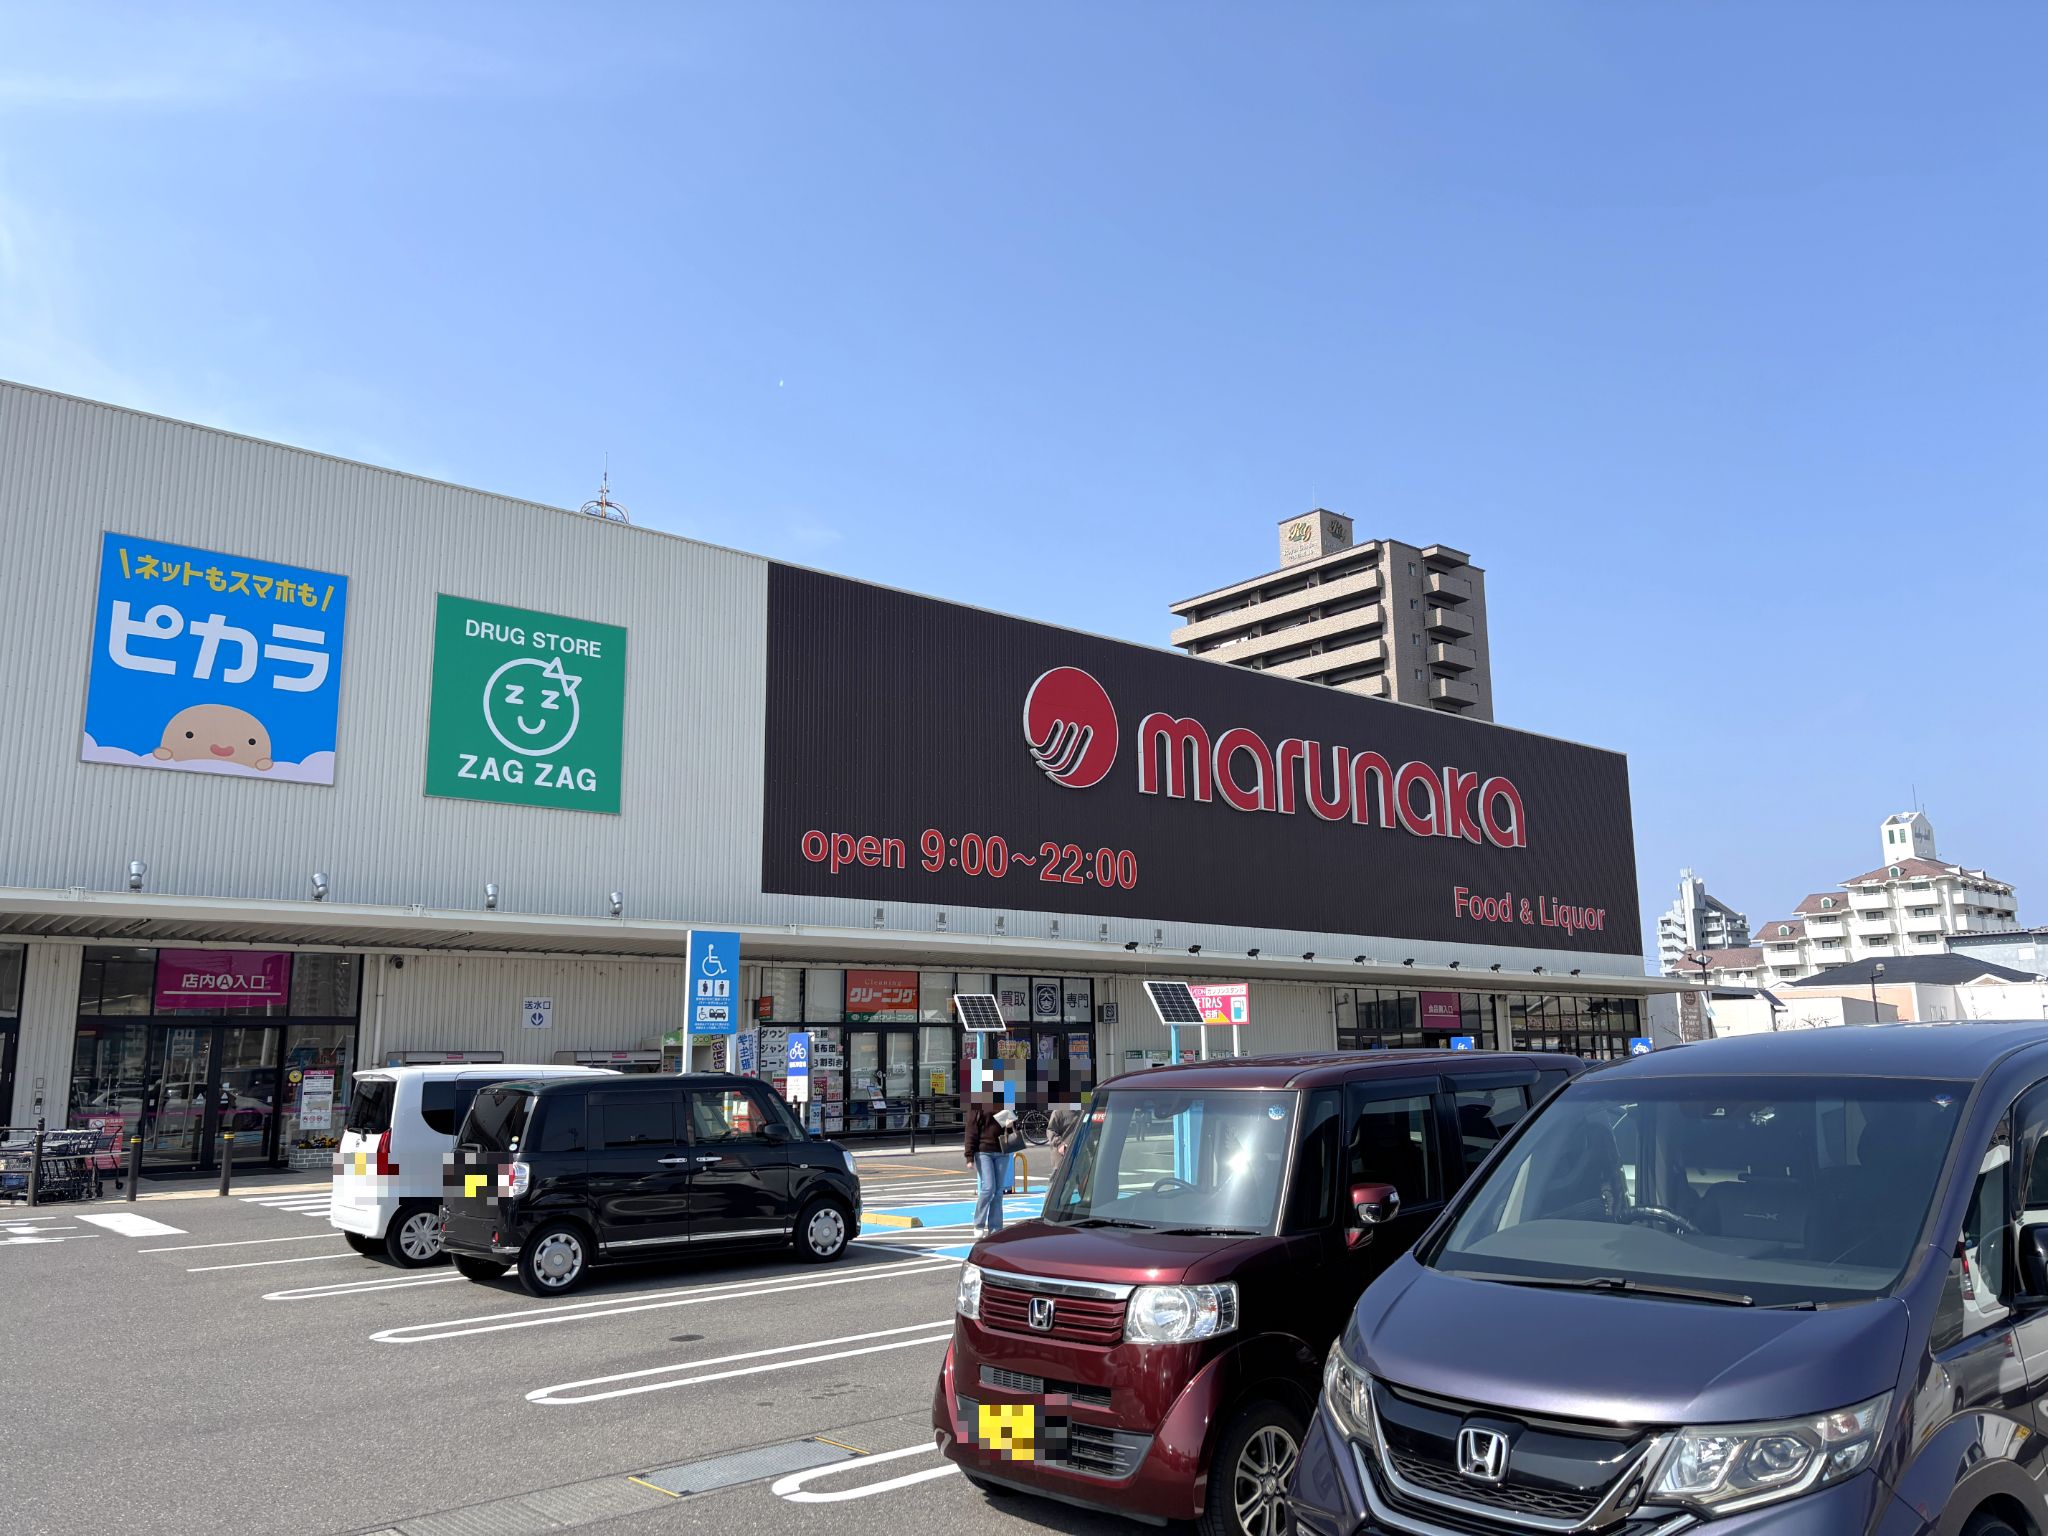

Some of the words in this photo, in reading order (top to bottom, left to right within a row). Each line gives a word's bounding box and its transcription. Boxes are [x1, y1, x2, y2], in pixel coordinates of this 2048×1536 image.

[107, 599, 331, 693] ピカラ
[465, 619, 526, 646] DRUG
[532, 629, 602, 659] STORE
[457, 753, 525, 785] ZAG
[533, 763, 598, 792] ZAG
[1136, 711, 1528, 850] marunaka
[800, 829, 906, 874] open
[1453, 886, 1514, 924] Food
[1519, 901, 1534, 926] &
[1538, 894, 1606, 938] Liquor
[524, 1001, 551, 1010] 送水口
[849, 987, 916, 1003] クリーニング
[1001, 990, 1025, 1007] 買取
[1066, 993, 1089, 1008] 専門
[761, 1030, 786, 1038] ダウン
[761, 1059, 785, 1068] コート
